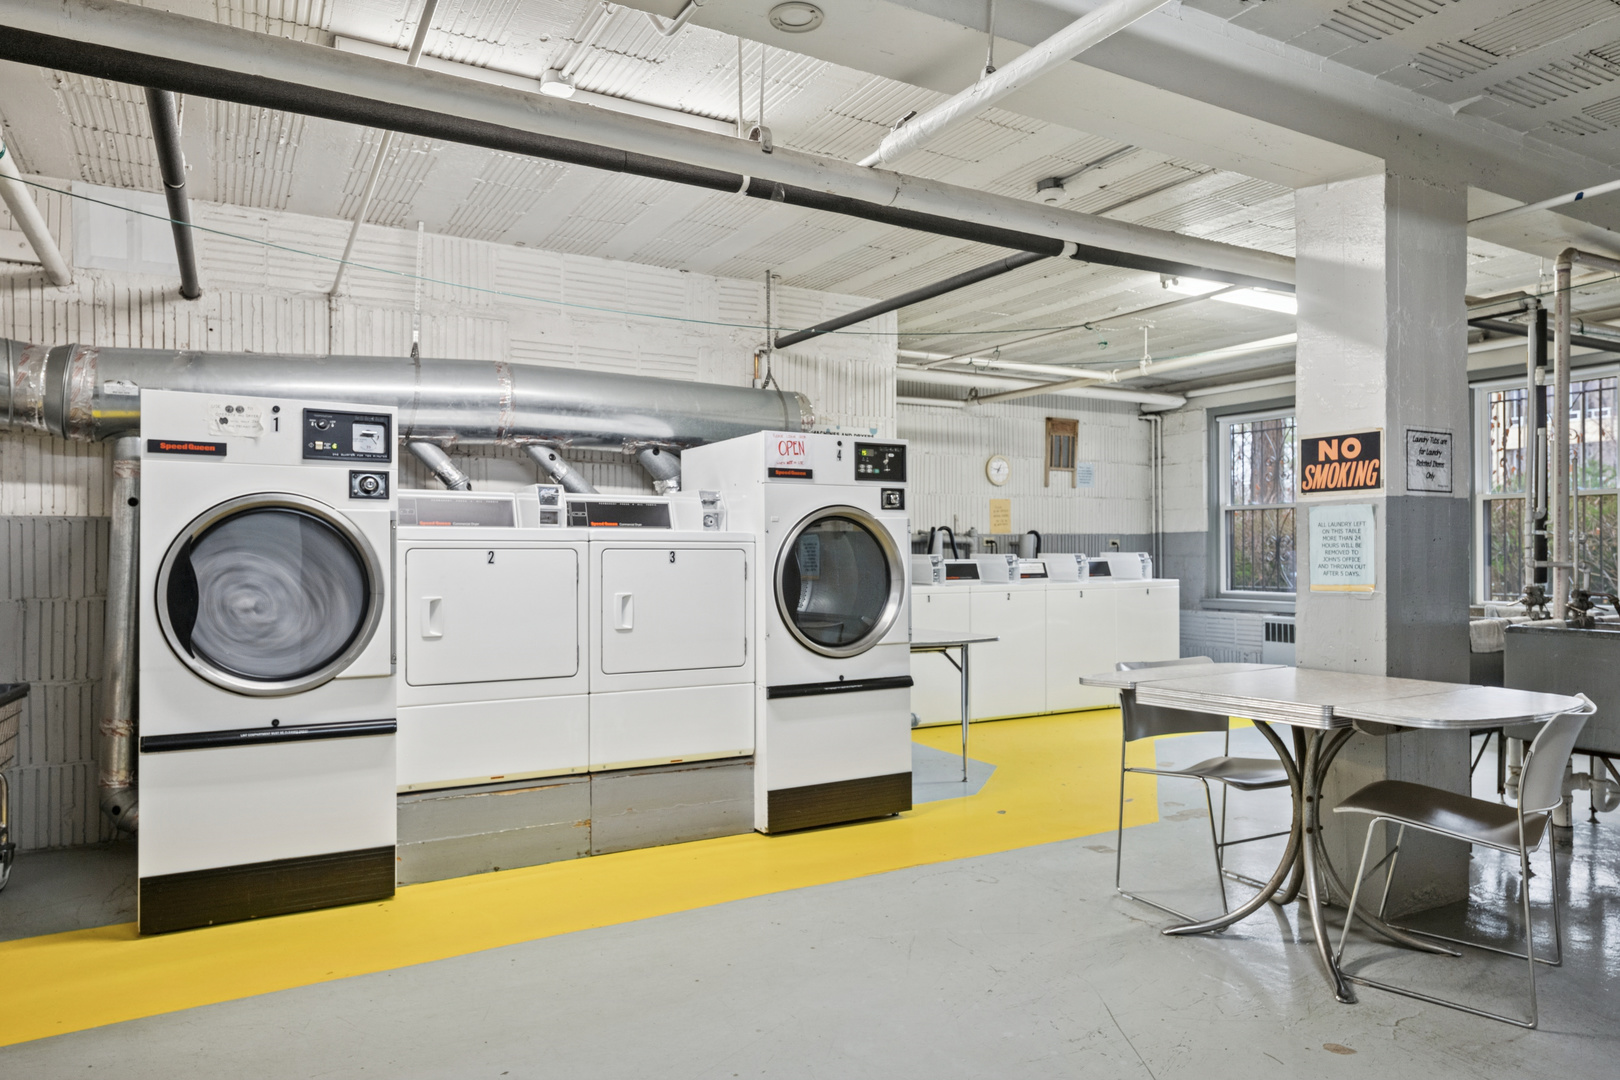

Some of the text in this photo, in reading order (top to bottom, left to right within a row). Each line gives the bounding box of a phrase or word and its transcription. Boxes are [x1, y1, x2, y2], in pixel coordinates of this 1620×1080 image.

[274, 417, 278, 432] 1
[1413, 435, 1429, 445] Laundry
[778, 440, 805, 456] OPEN
[1318, 437, 1362, 461] NO
[1426, 448, 1442, 458] Laundry
[837, 449, 841, 461] 4
[1302, 459, 1380, 490] SMOKING
[1426, 472, 1435, 481] Only
[488, 551, 494, 564] 2
[670, 551, 675, 563] 3
